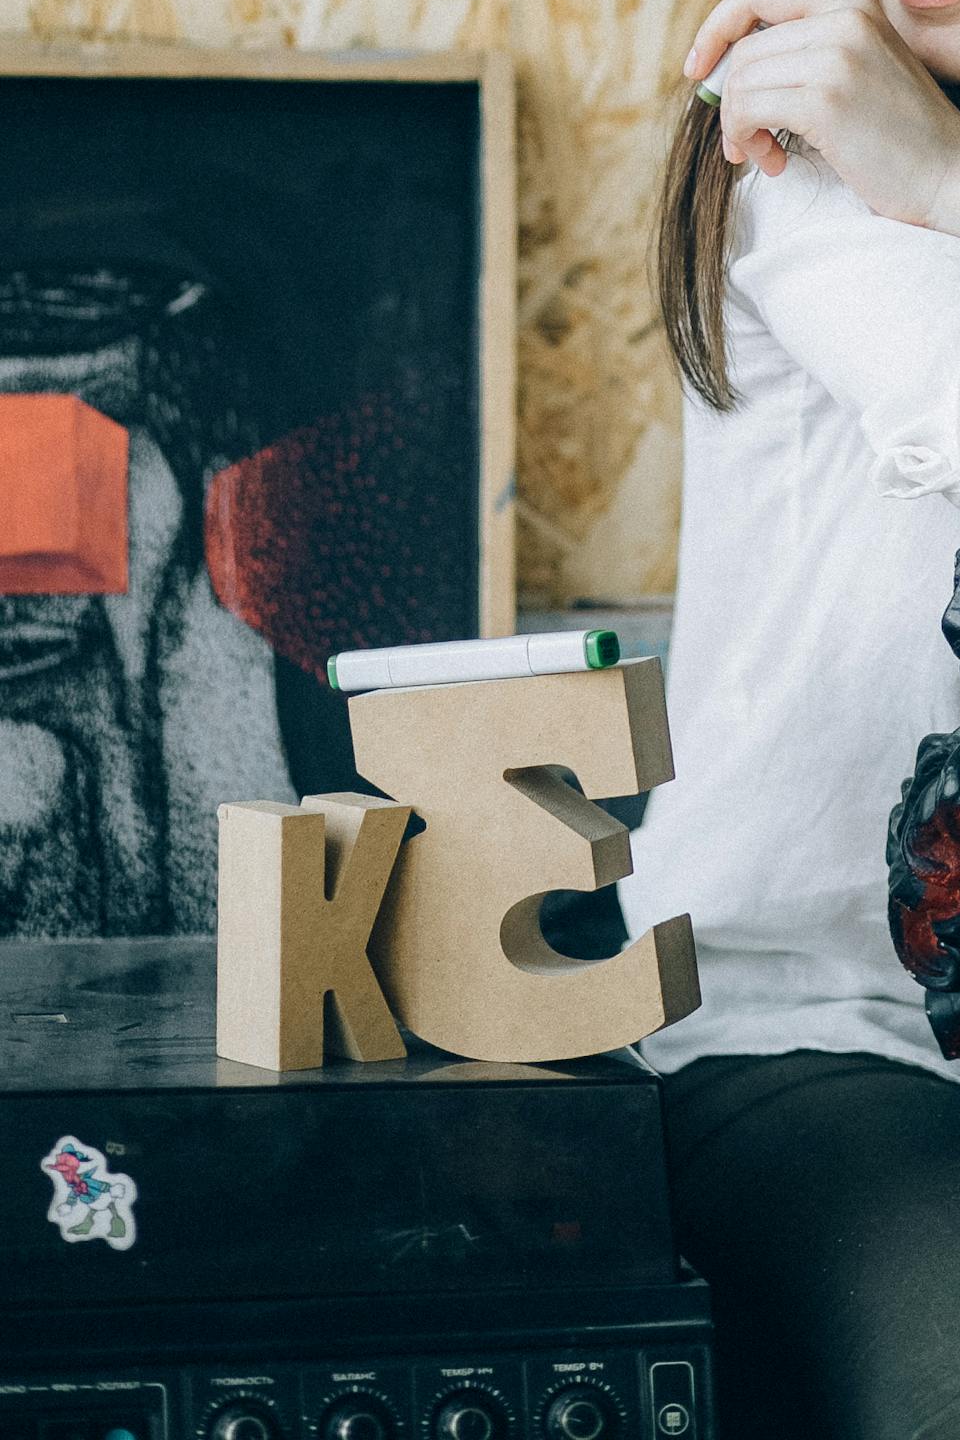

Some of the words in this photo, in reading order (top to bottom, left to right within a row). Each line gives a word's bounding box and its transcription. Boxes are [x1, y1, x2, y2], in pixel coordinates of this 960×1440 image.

[217, 792, 412, 1072] K
[440, 1368, 474, 1377] ТЕМБР
[553, 1363, 586, 1372] ТЕМБР
[210, 1376, 275, 1386] ГРОМКОСТЬ
[332, 1371, 376, 1381] БАЛАНС
